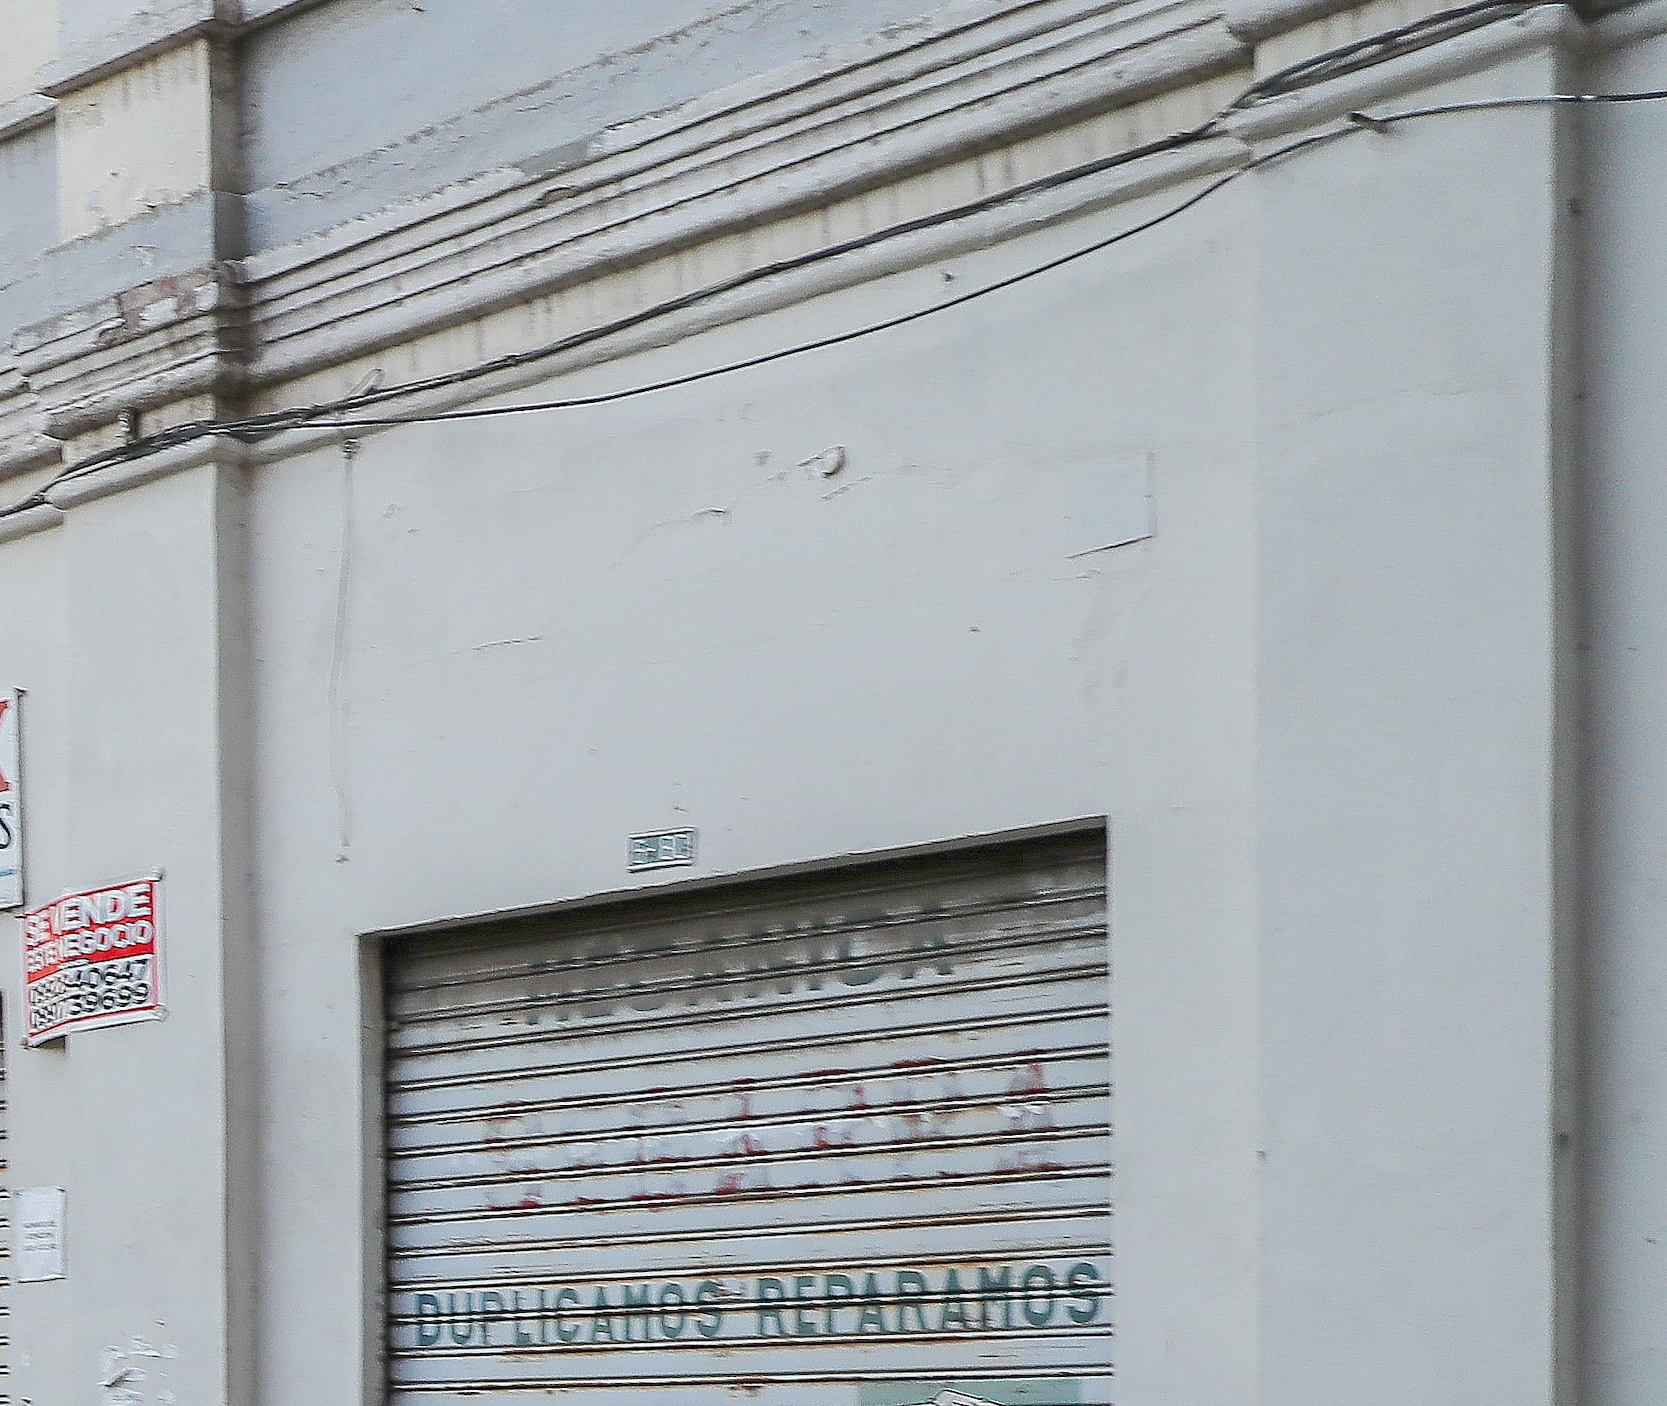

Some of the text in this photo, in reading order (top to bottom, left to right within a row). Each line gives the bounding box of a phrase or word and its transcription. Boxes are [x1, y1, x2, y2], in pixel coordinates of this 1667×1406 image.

[51, 882, 152, 934] VENDE
[415, 1261, 1102, 1347] DUPLICAMOS REPARAMOS
